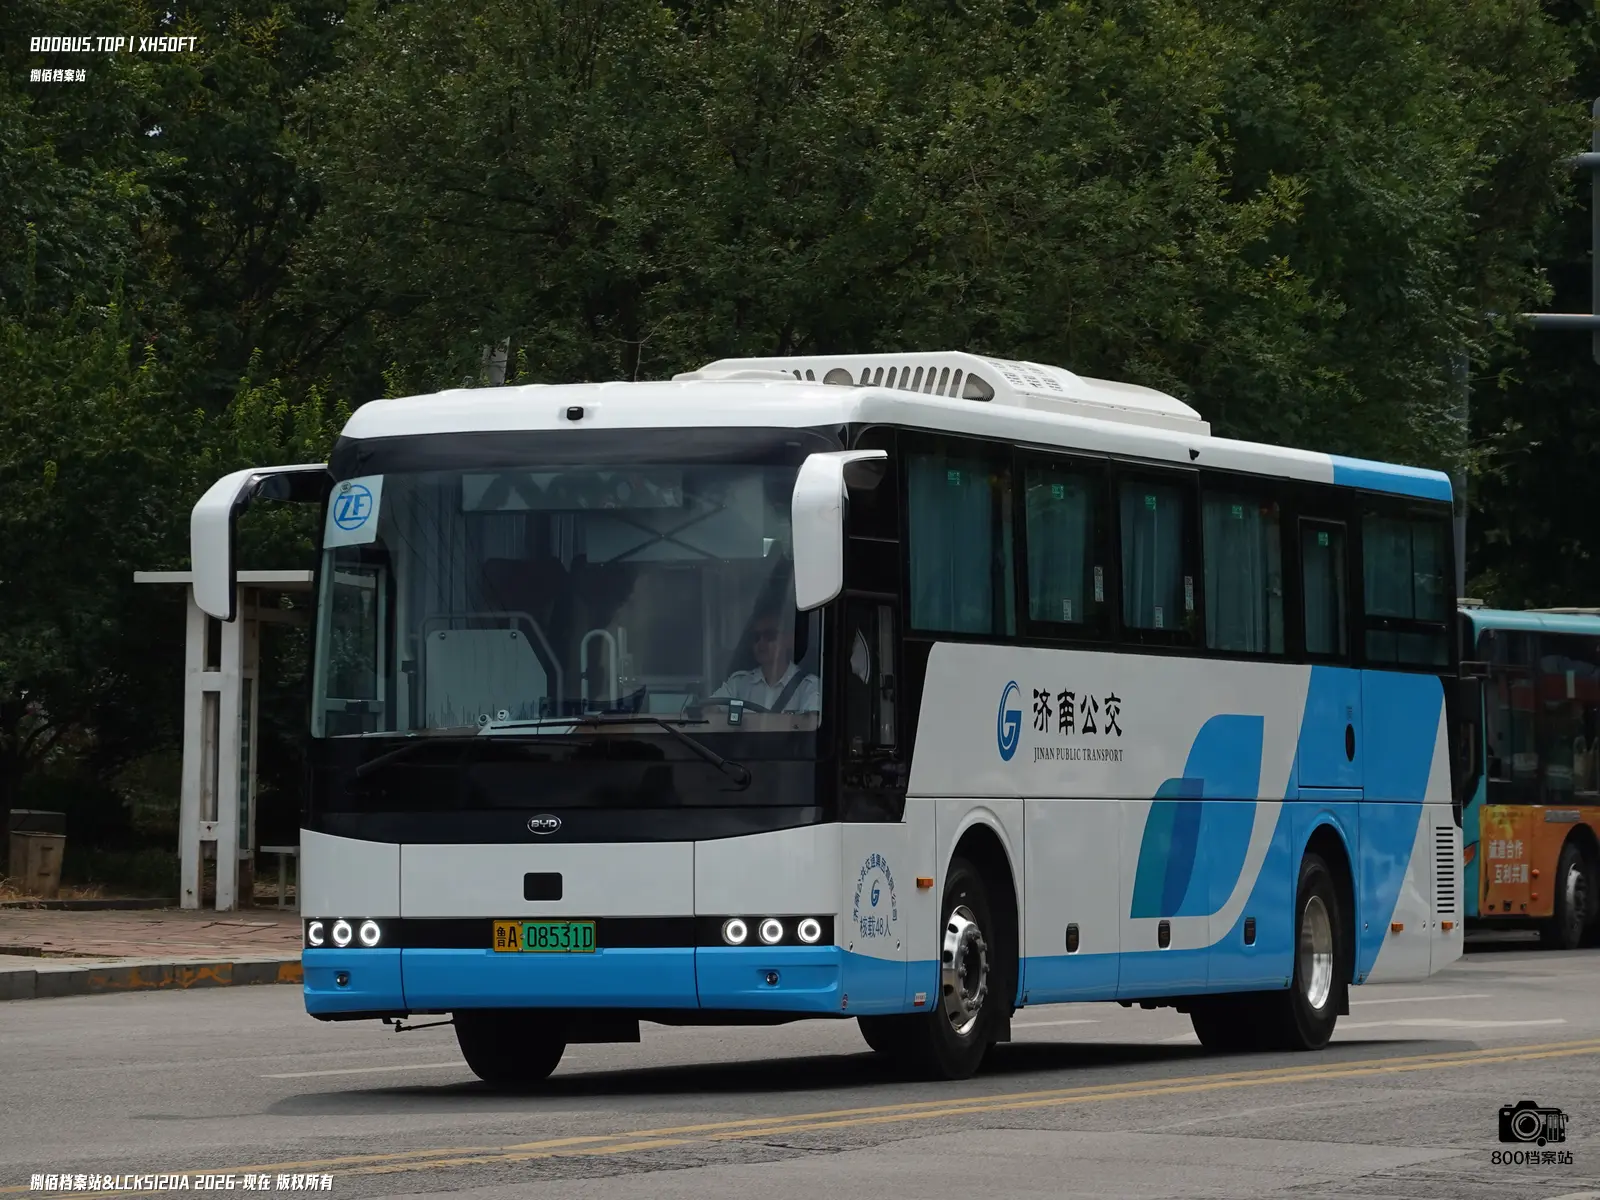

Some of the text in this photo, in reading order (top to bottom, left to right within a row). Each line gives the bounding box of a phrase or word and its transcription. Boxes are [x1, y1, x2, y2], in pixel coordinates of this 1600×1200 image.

[338, 494, 370, 521] ZF
[1033, 687, 1123, 737] 济南公交
[1033, 747, 1123, 763] JINAN PUBLIC TRANSPORT
[531, 819, 558, 828] BYD
[860, 914, 892, 939] 核载48人
